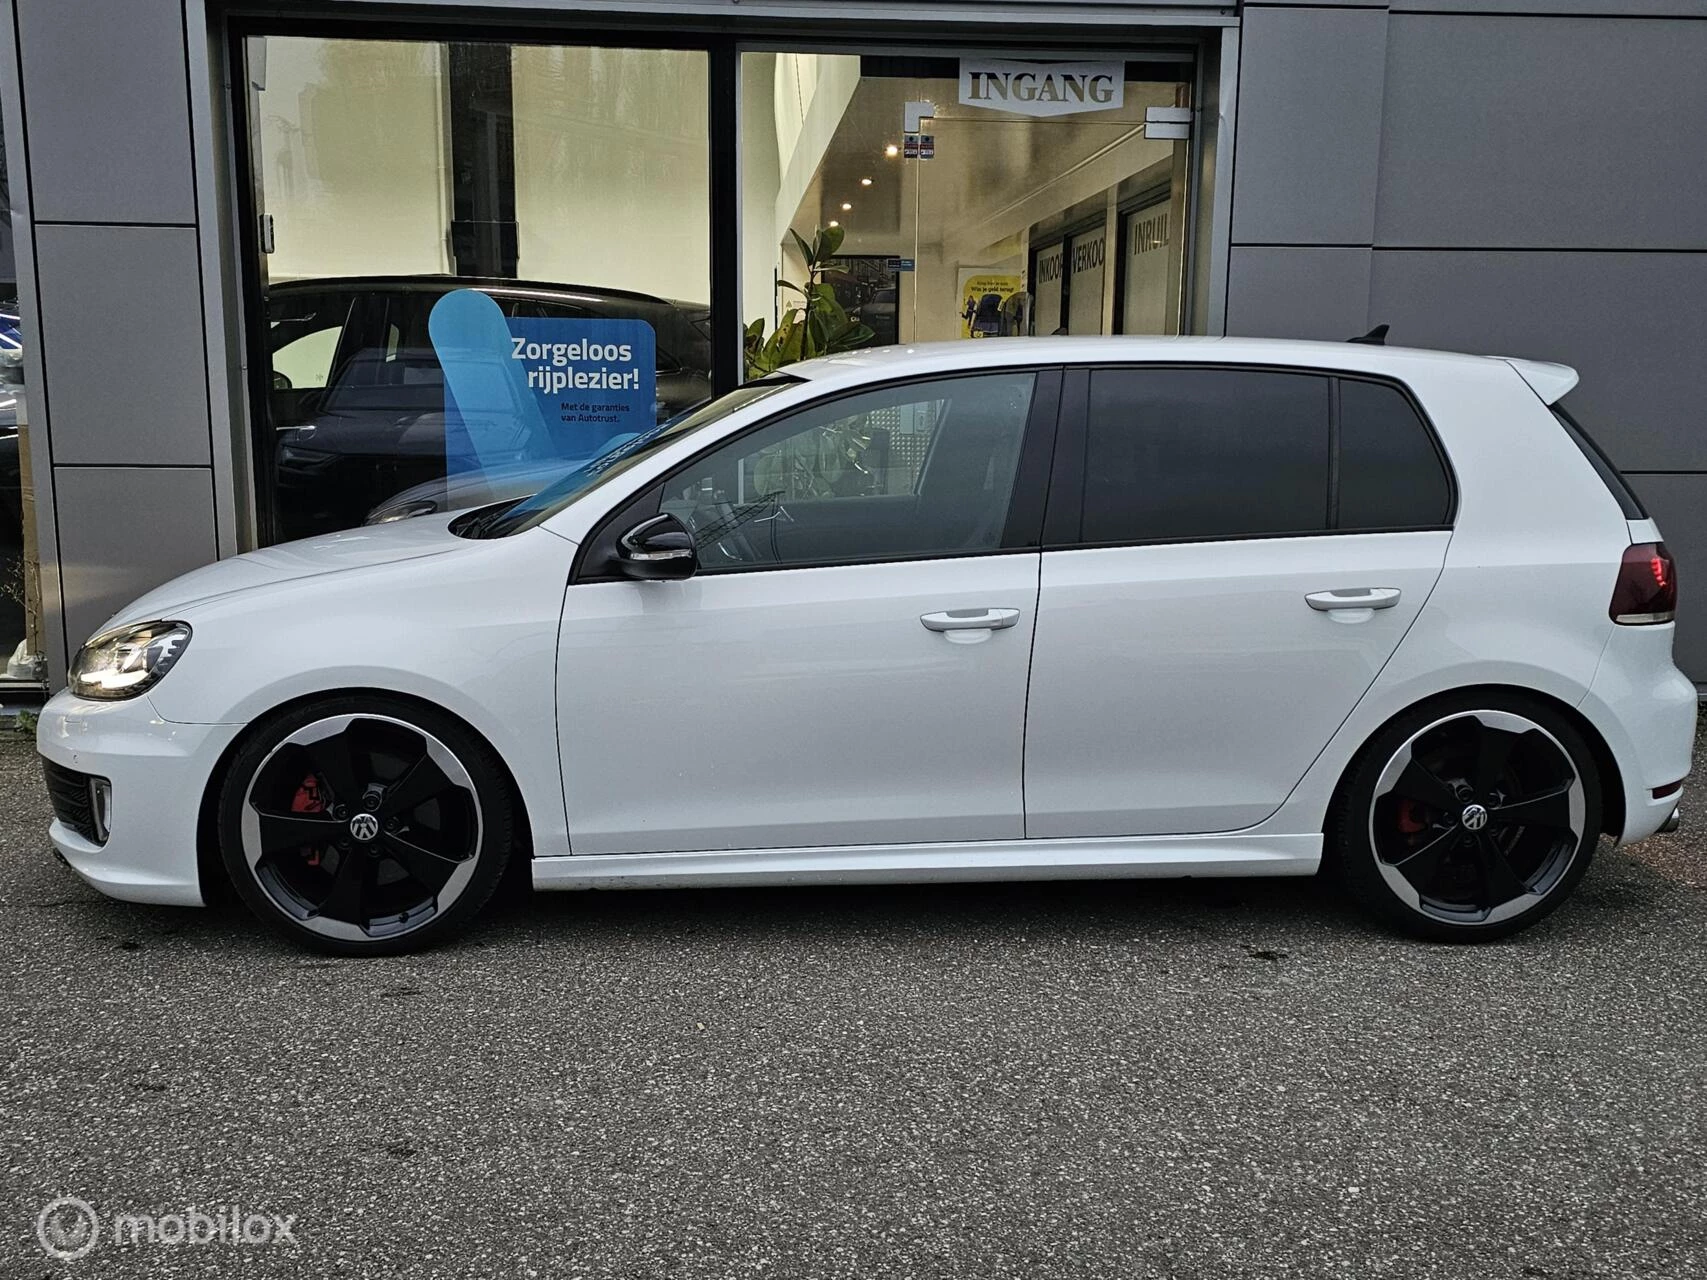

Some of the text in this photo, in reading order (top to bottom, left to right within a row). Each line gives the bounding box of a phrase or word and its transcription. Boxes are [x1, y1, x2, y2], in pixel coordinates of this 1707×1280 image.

[968, 71, 1114, 103] INGANG
[1134, 213, 1169, 255] INRUIL
[1073, 237, 1105, 273] VERKOO
[511, 337, 632, 367] Zorgeloos
[528, 366, 639, 394] rijplezier!
[561, 403, 630, 413] Met de garanties
[578, 413, 620, 423] Autotrust.
